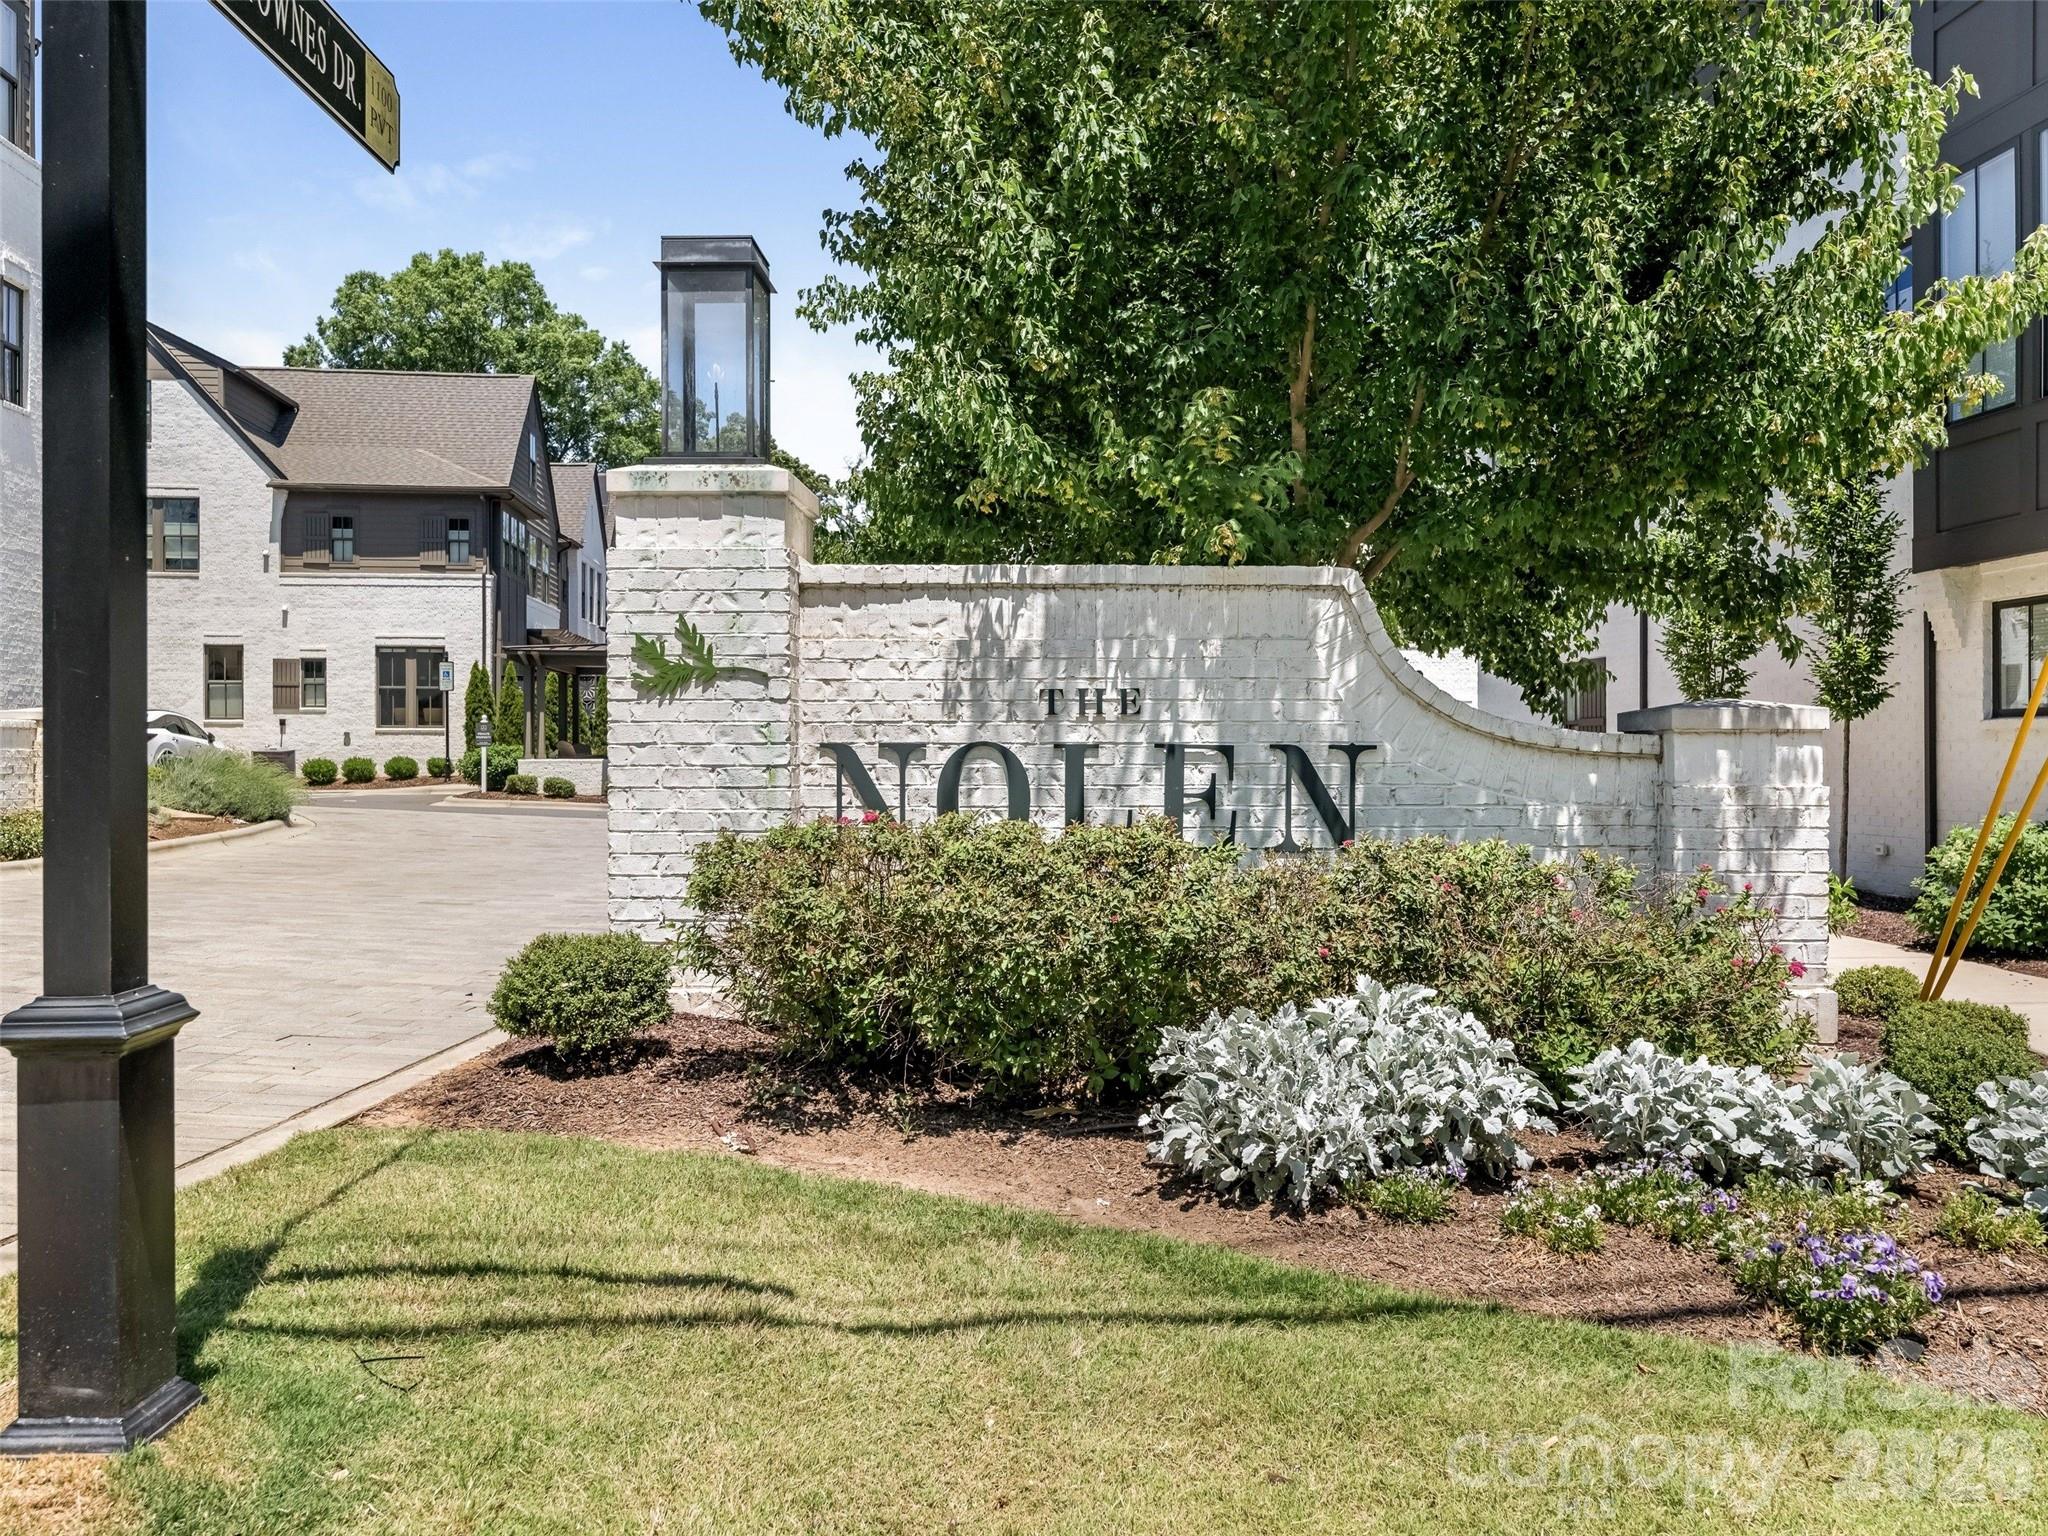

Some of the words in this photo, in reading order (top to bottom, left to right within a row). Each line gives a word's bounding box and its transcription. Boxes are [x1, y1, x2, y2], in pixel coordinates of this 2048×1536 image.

[249, 0, 327, 75] WNES
[333, 40, 362, 111] DR.
[371, 74, 393, 112] 1100
[370, 106, 394, 145] PVT
[1039, 688, 1142, 719] THE
[820, 741, 1377, 852] NOLEN
